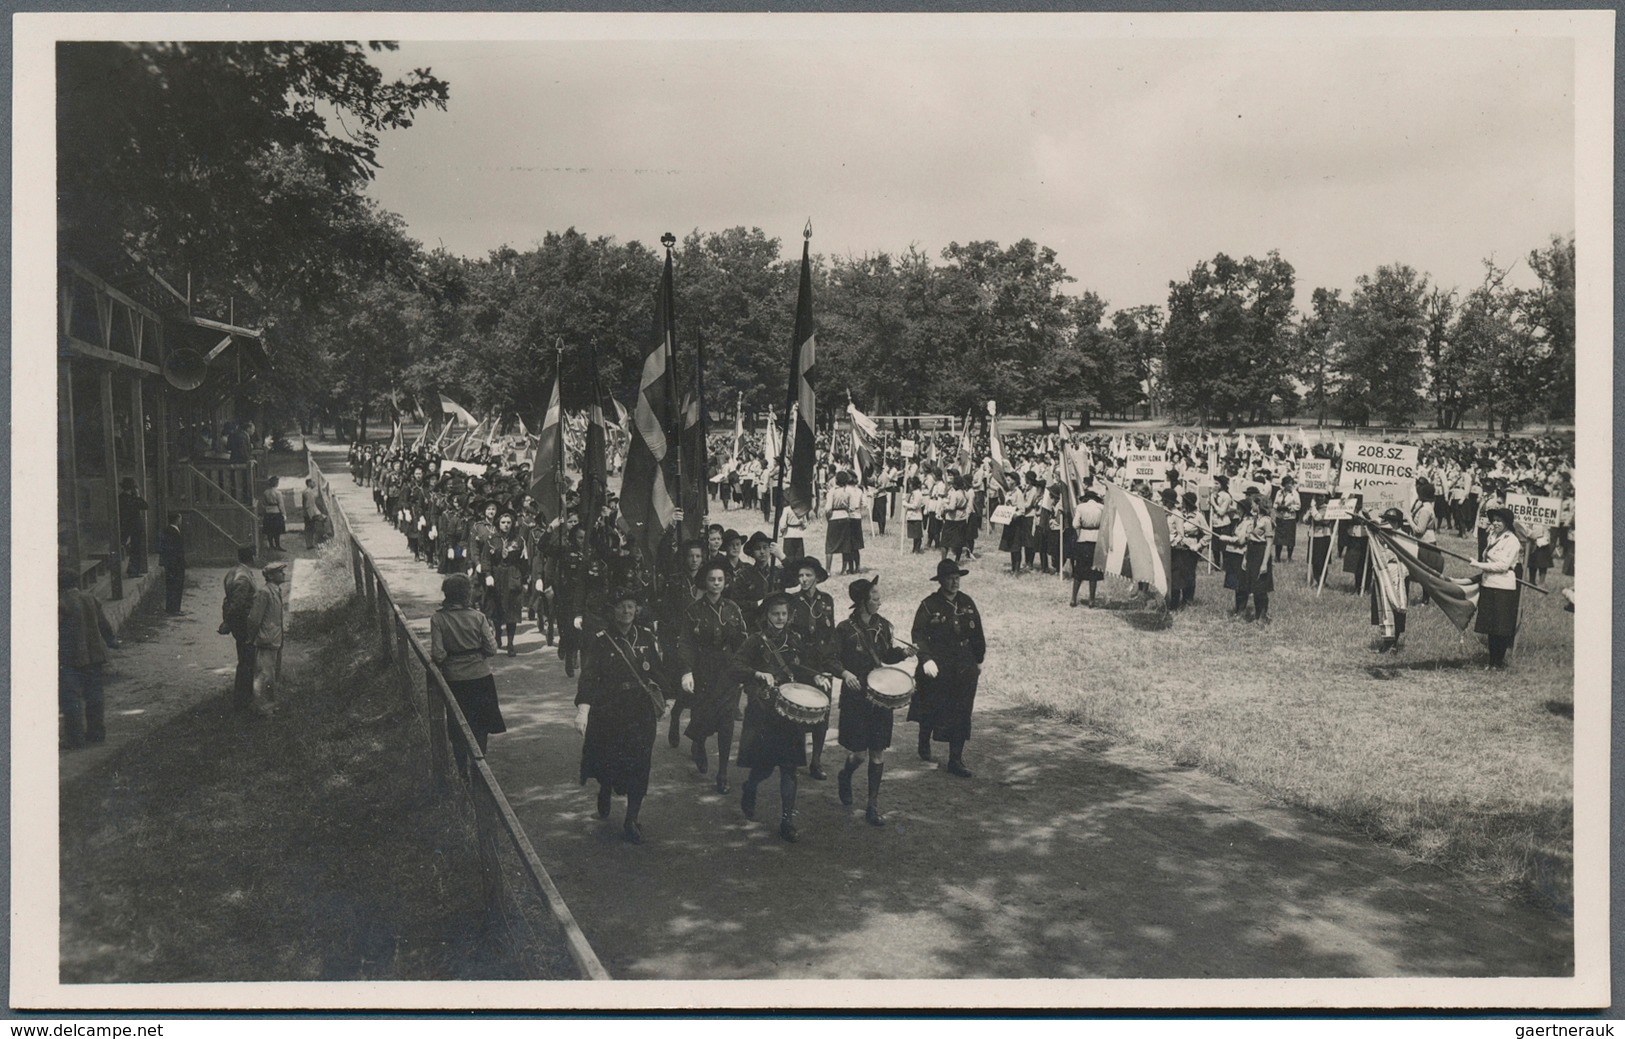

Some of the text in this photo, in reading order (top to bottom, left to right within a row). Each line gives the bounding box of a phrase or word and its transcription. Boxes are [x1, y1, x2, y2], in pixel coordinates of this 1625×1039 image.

[1302, 462, 1325, 471] BUDAPEST
[1527, 497, 1539, 506] VII
[1508, 504, 1557, 518] DEBRECEN
